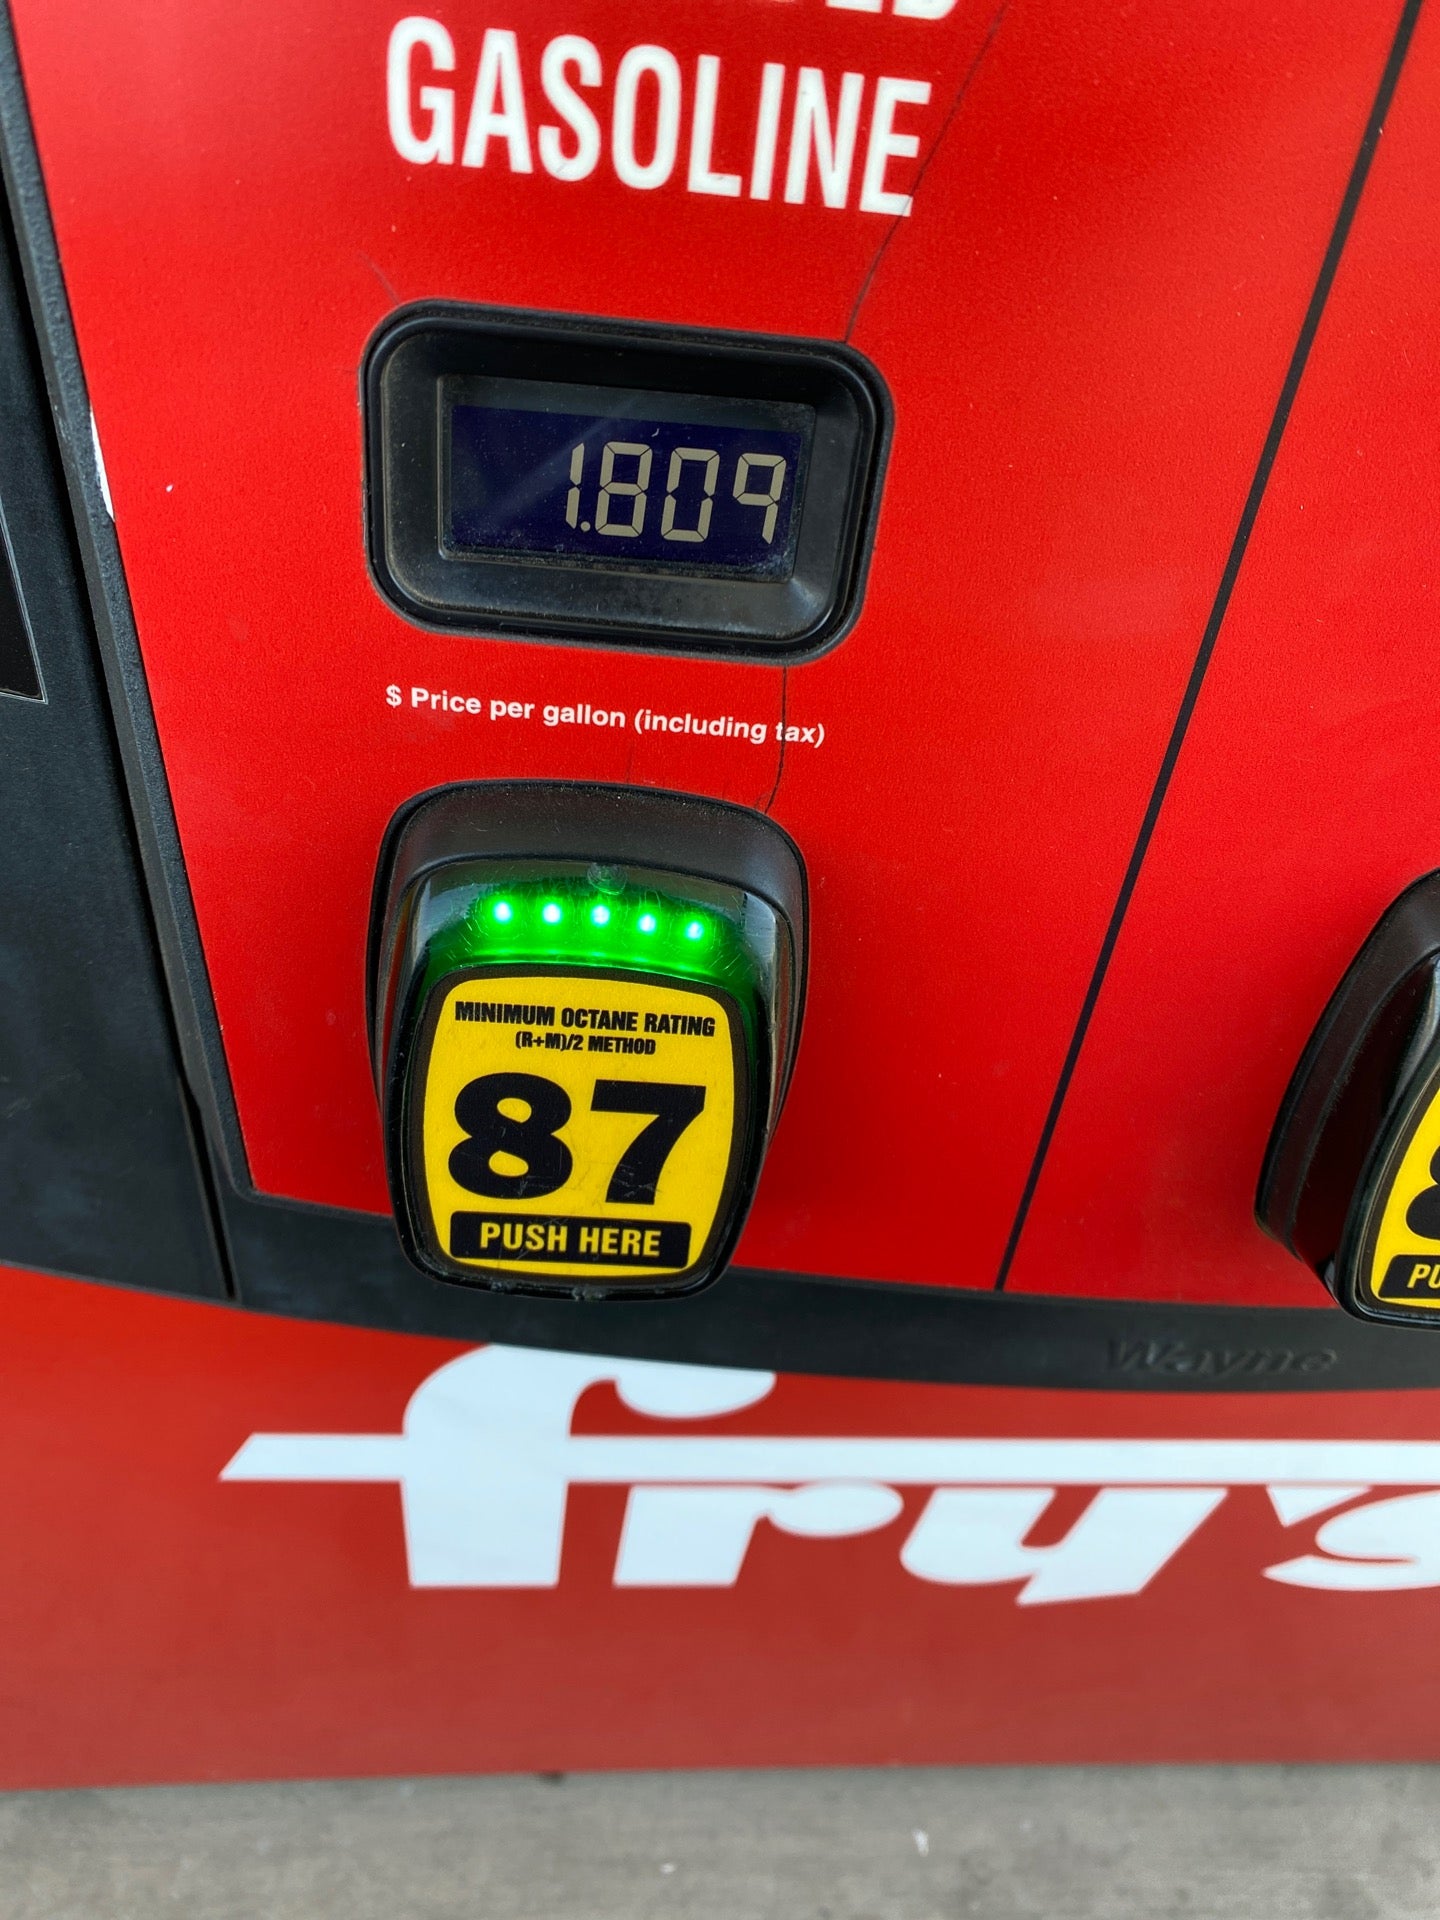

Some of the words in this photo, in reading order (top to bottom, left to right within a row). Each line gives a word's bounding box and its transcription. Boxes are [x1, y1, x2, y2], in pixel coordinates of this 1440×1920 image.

[386, 16, 932, 217] GASOLINE
[565, 441, 787, 545] 1.809
[385, 684, 402, 708] $
[410, 686, 482, 715] Price
[489, 700, 535, 721] per
[542, 704, 626, 728] gallon
[633, 708, 768, 744] (including
[774, 719, 826, 748] tax)
[455, 1000, 555, 1026] MINIMUM
[560, 1007, 638, 1031] OCTANE
[643, 1013, 716, 1037] RATING
[515, 1030, 584, 1052] (R+M)/2
[587, 1035, 657, 1055] METHOD
[448, 1072, 707, 1206] 87
[479, 1221, 567, 1252] PUSH
[579, 1227, 662, 1257] HERE
[1107, 1340, 1338, 1377] Wayne
